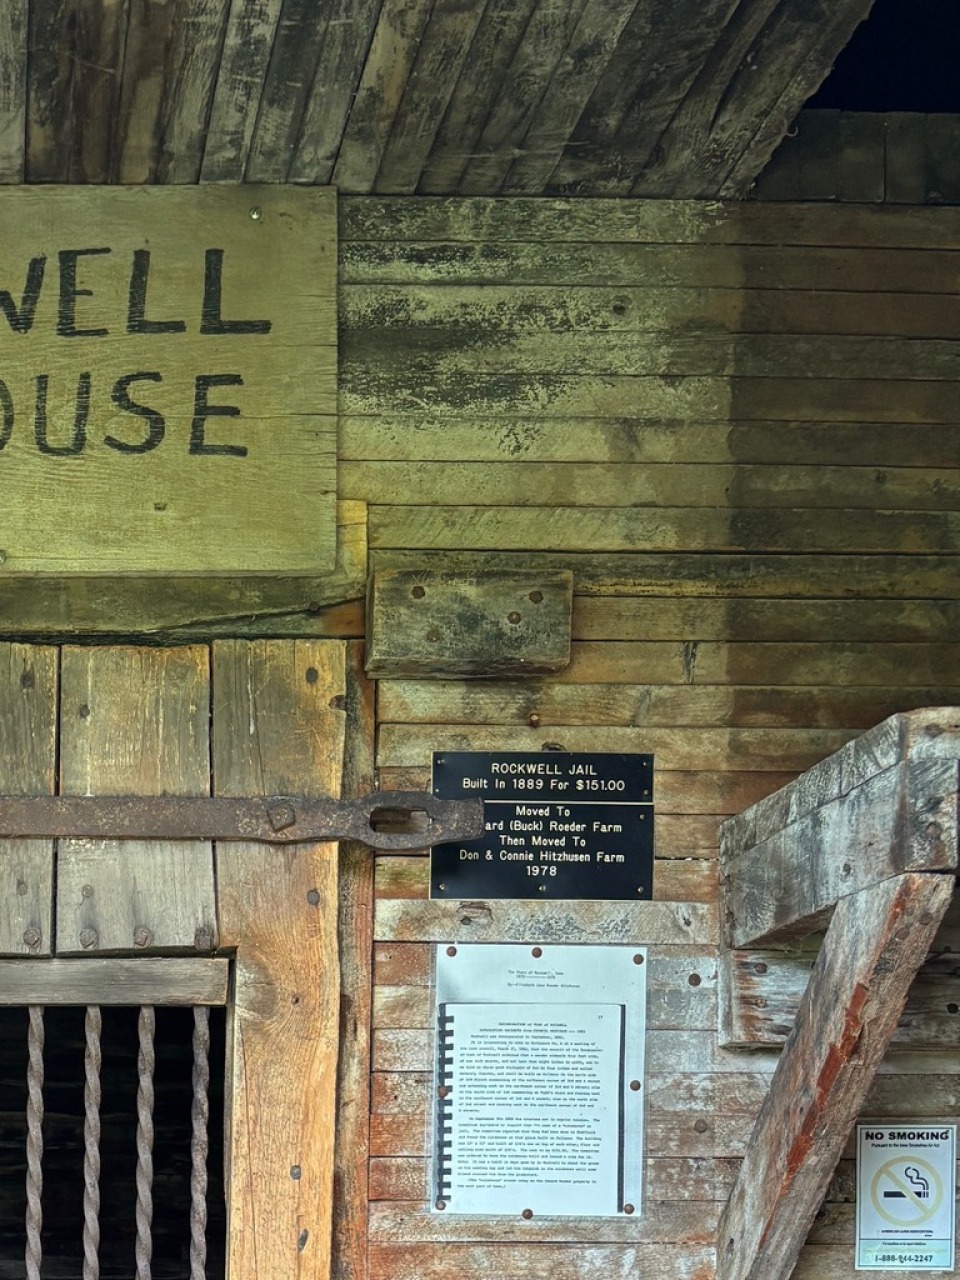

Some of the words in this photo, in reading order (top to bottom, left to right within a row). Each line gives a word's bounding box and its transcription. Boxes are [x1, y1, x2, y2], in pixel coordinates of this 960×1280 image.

[492, 763, 561, 774] ROCKWELL
[569, 765, 596, 775] JAIL
[463, 778, 487, 788] Built
[496, 779, 505, 788] In
[513, 779, 543, 789] 1889
[551, 780, 569, 790] For
[576, 780, 625, 790] $151.00
[516, 806, 549, 816] Moved
[557, 806, 570, 816] To
[510, 820, 542, 830] (Buck)
[550, 821, 586, 831] Roeder
[594, 822, 621, 832] Farm
[500, 835, 525, 845] Then
[532, 836, 565, 846] Moved
[573, 836, 585, 846] To
[460, 850, 479, 860] Don
[486, 850, 492, 860] &
[500, 850, 534, 860] Connie
[540, 851, 590, 861] Hitzhusen
[597, 852, 624, 862] Farm
[527, 866, 556, 876] 1978
[865, 1131, 884, 1140] NO
[889, 1130, 949, 1140] SMOKING
